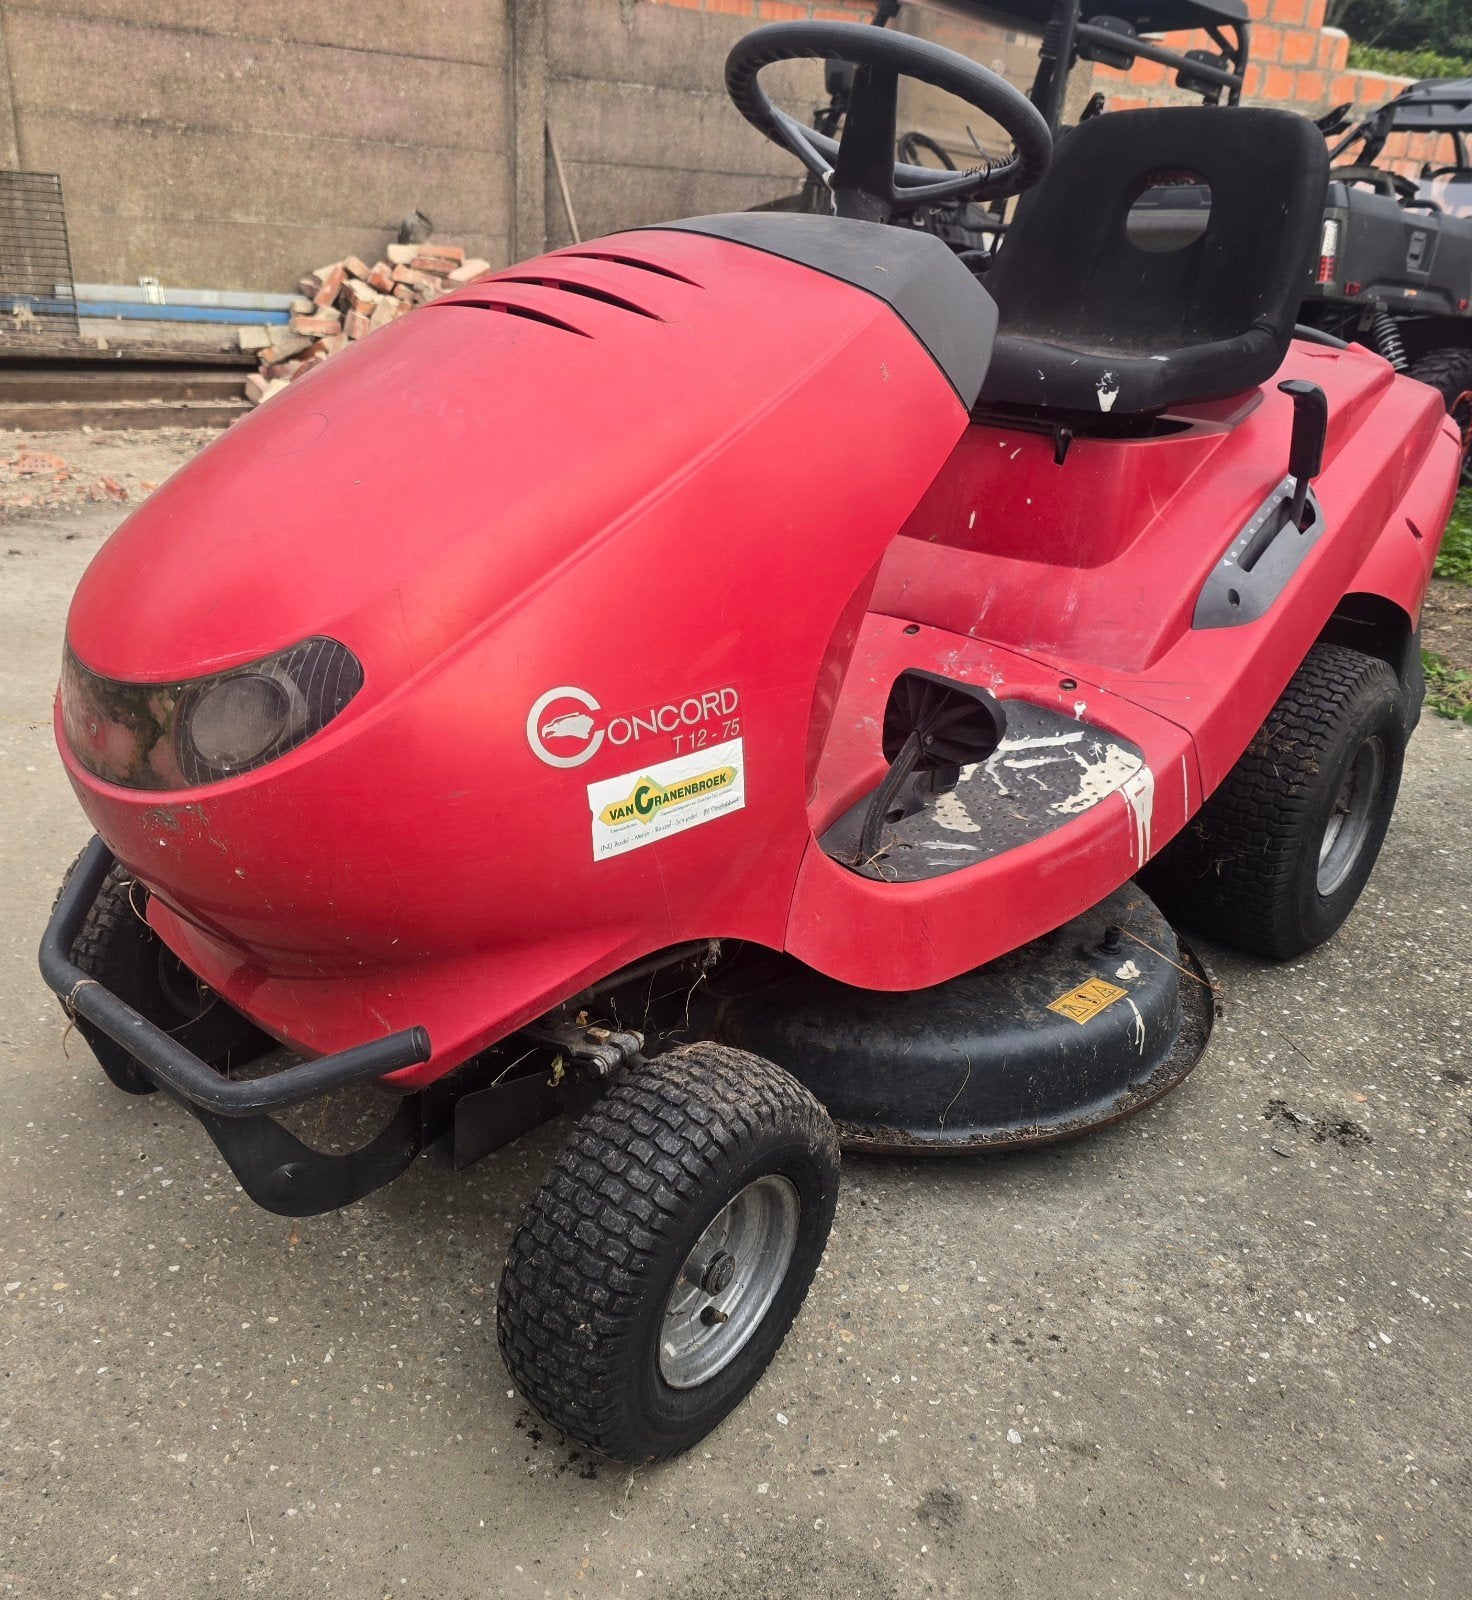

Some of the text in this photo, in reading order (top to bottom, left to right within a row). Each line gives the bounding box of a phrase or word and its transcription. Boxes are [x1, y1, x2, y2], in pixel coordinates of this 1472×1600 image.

[526, 686, 739, 768] CONCORD
[672, 734, 684, 754] T
[689, 730, 707, 749] 12
[722, 717, 740, 739] 75
[609, 803, 634, 820] VAN
